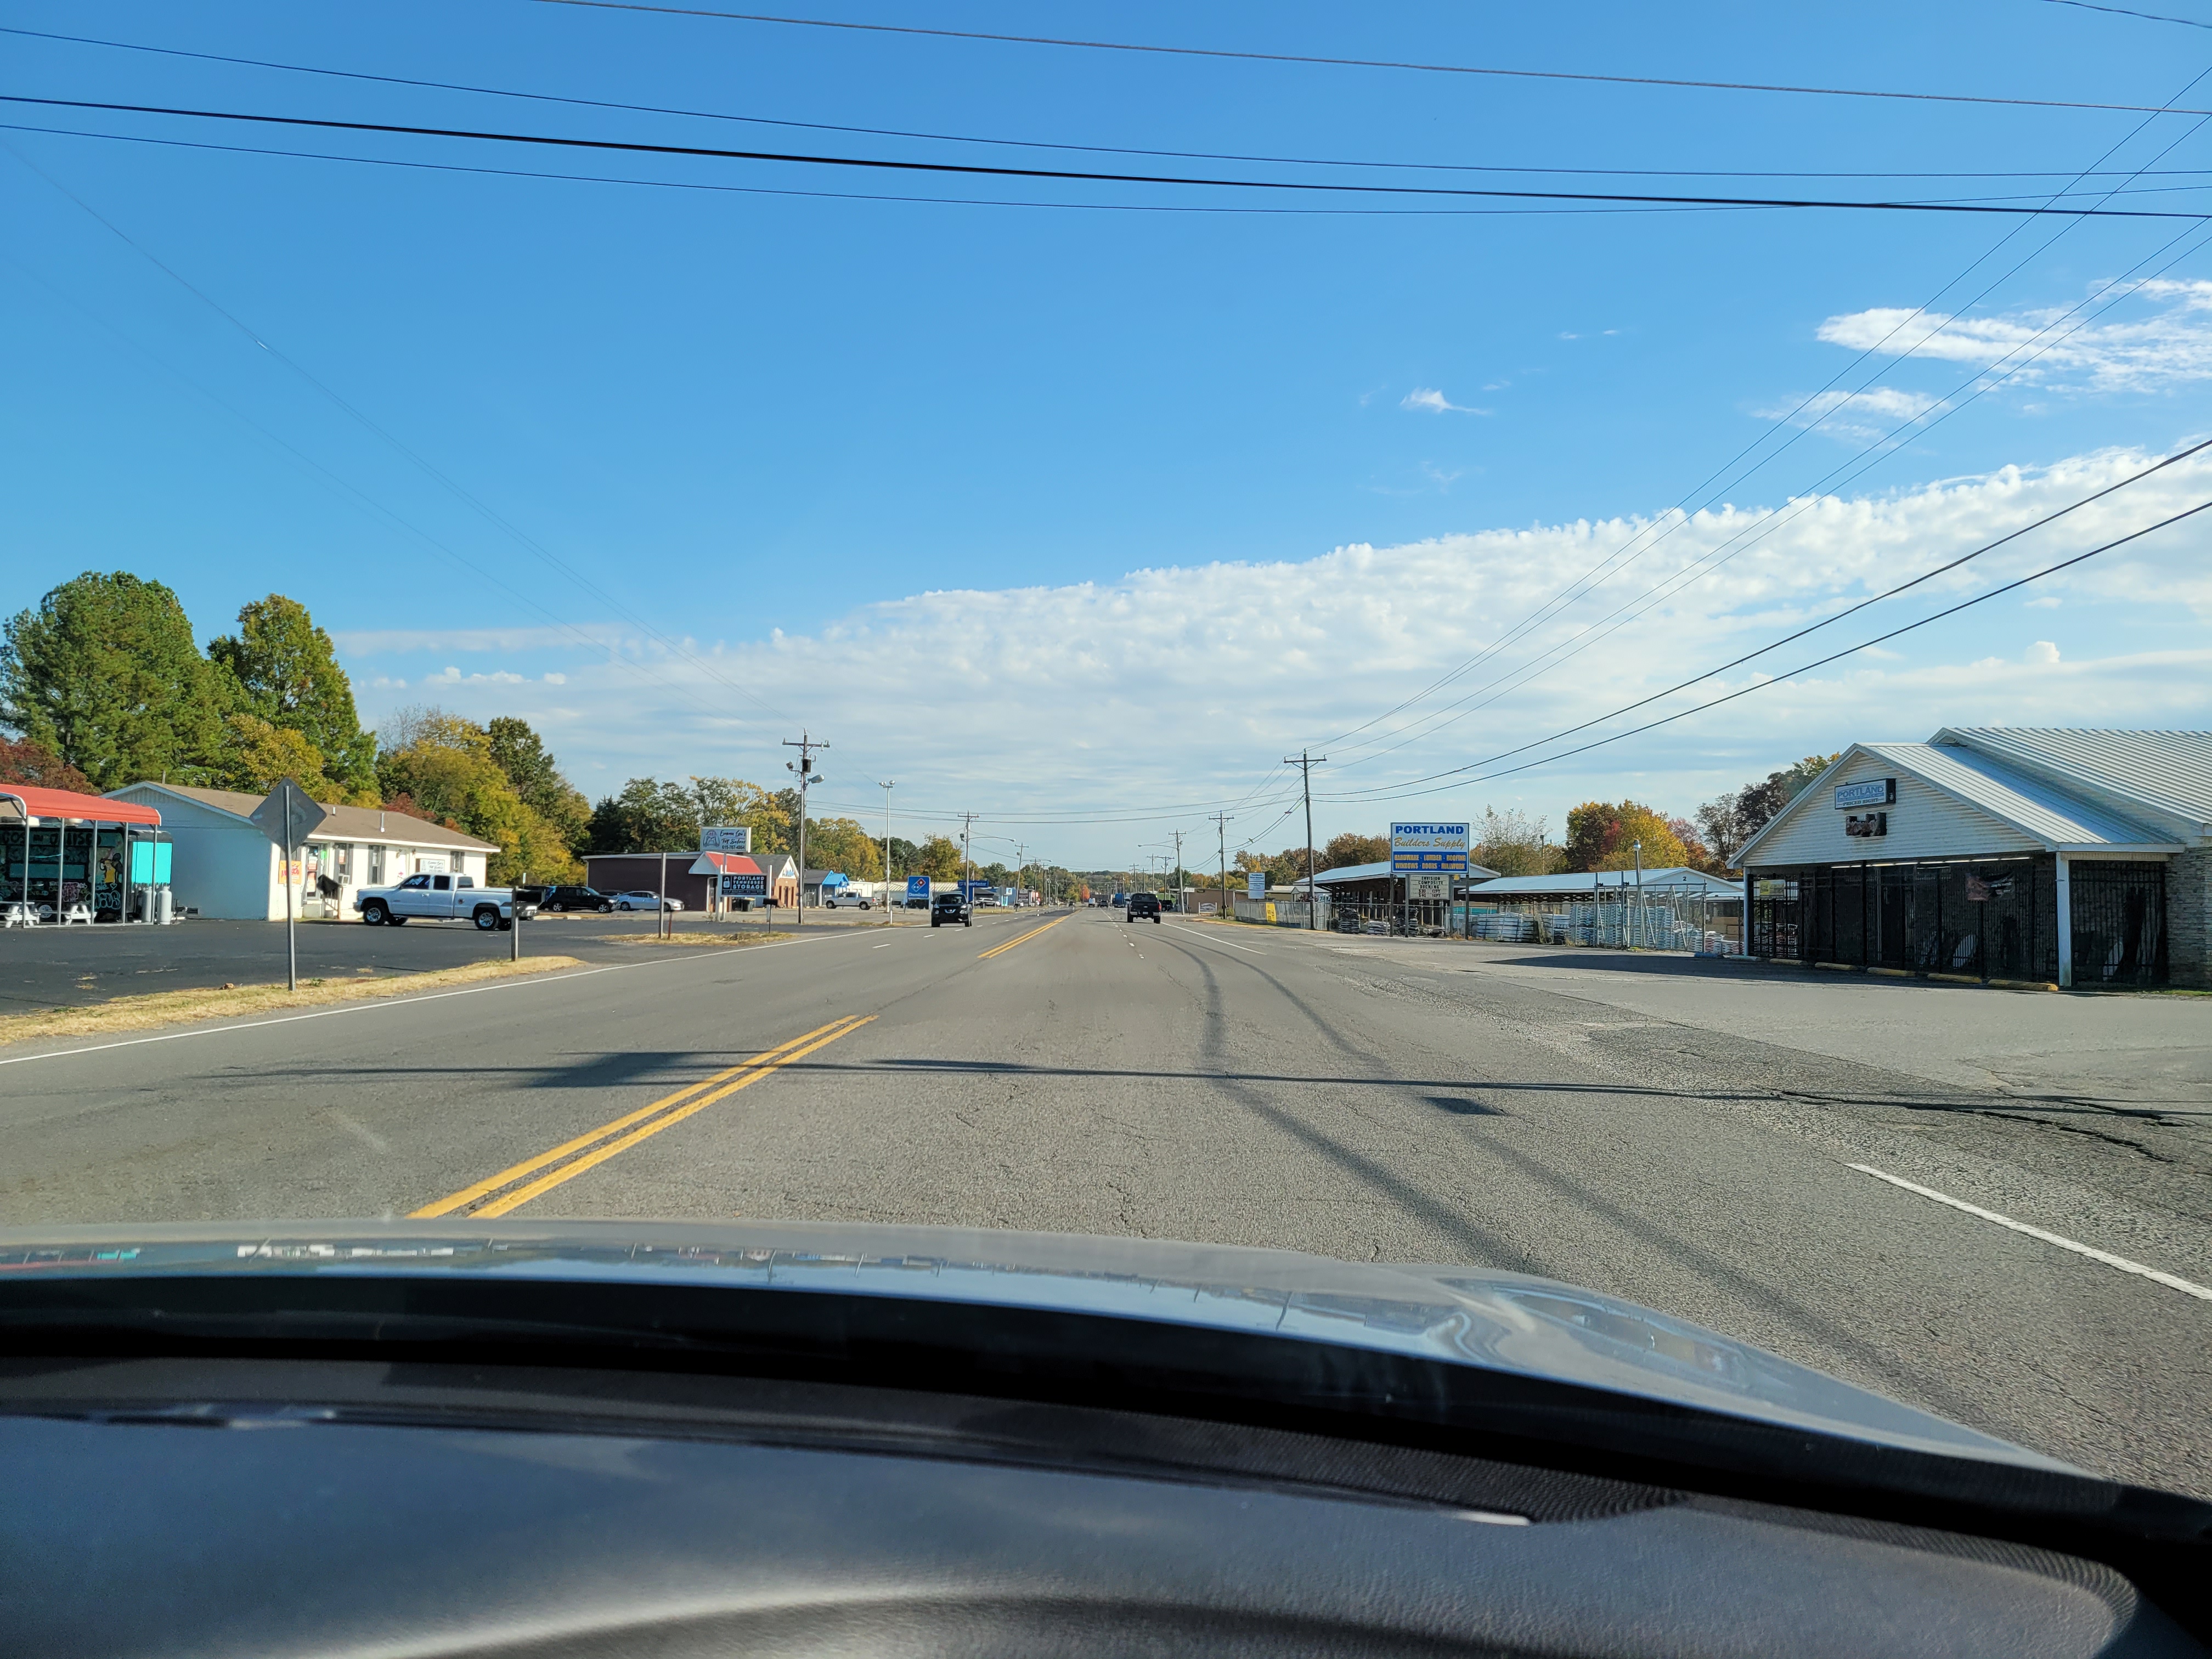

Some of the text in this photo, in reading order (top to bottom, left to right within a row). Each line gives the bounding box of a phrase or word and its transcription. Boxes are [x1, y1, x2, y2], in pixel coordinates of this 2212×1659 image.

[1837, 786, 1883, 798] PORTLAND
[1395, 826, 1464, 834] PORTLAND
[1394, 837, 1466, 850] Builders Supply
